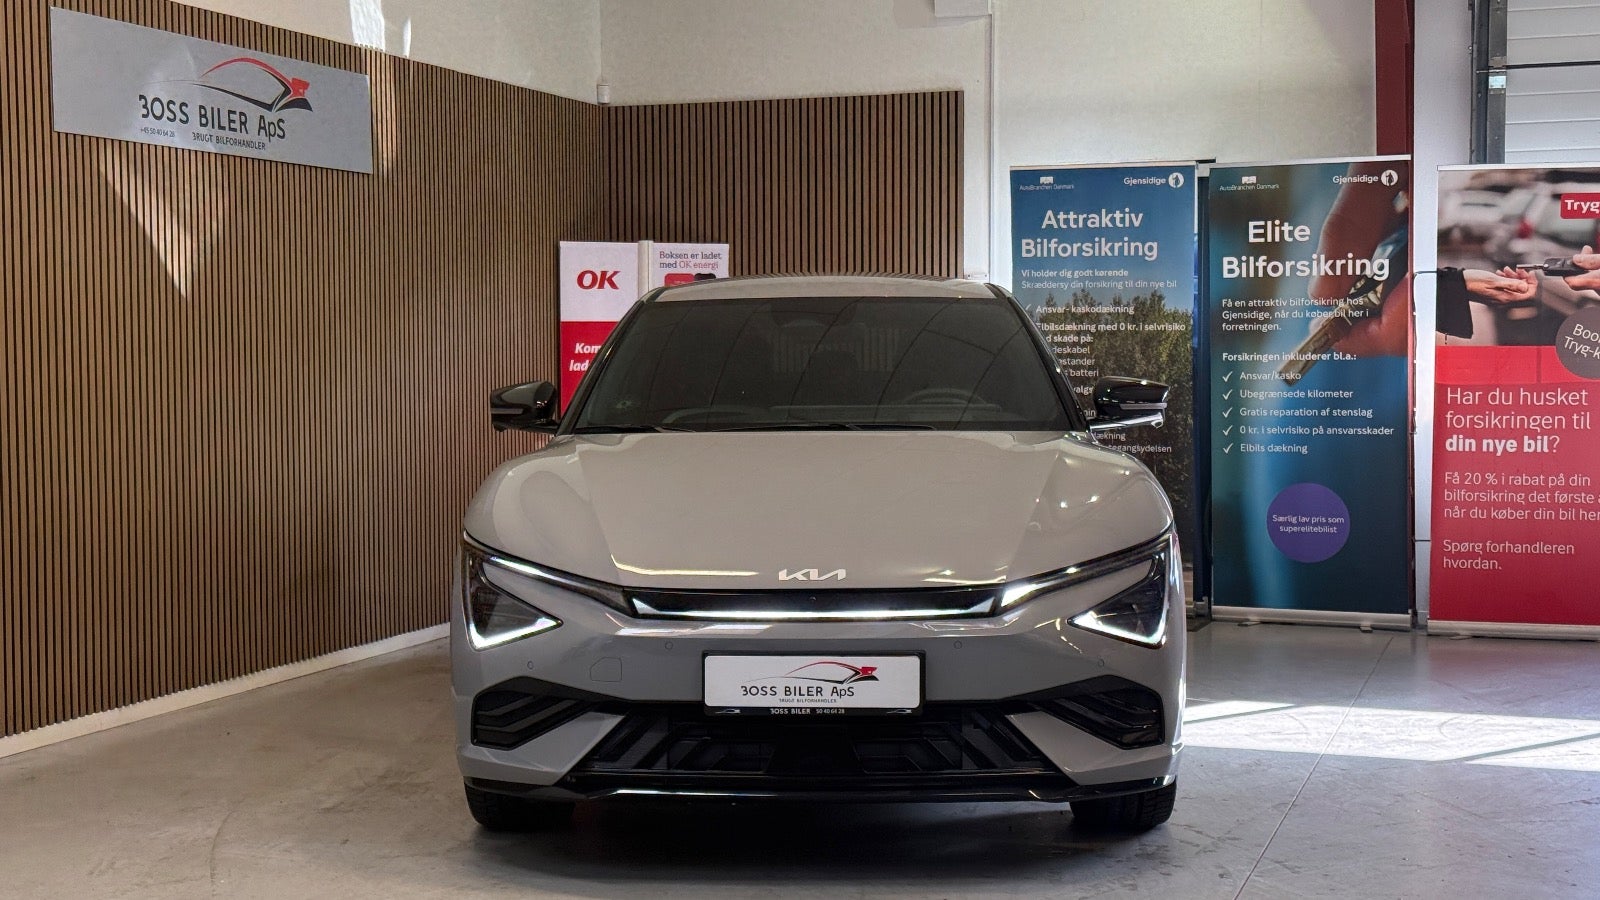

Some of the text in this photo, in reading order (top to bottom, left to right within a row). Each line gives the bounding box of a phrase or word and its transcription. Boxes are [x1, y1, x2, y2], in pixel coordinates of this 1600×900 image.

[198, 104, 249, 134] BILER
[257, 114, 286, 142] ApS
[215, 135, 266, 150] BILFORHANDLER
[1123, 176, 1167, 186] Gjensidige
[1332, 174, 1379, 186] Gjensidige
[1564, 199, 1600, 214] Tryg
[1041, 207, 1143, 229] Attraktiv
[1248, 219, 1311, 243] Elite
[1021, 236, 1158, 261] Bilforsikring
[659, 251, 722, 260] Boksen er ladet
[659, 260, 719, 271] med OK energi
[1222, 252, 1390, 281] Bilforsikring
[576, 269, 621, 290] OK
[1021, 268, 1129, 279] Vi holder dig godt kørende
[1021, 279, 1177, 290] Skræddersy din forsikring til din nye bil
[1222, 298, 1233, 308] Få
[1248, 298, 1287, 307] attraktiv
[1289, 297, 1345, 309] bilforsikring
[1346, 297, 1364, 306] hos
[1071, 304, 1135, 315] kaskodækning
[1222, 309, 1272, 321] Gjensidige,
[1274, 309, 1290, 319] når
[1291, 309, 1304, 318] du
[1305, 309, 1334, 318] køber
[1334, 309, 1346, 318] bil
[1347, 308, 1363, 317] her
[1097, 322, 1118, 331] med
[1119, 322, 1126, 331] 0
[1127, 322, 1139, 331] kr.
[1144, 322, 1186, 331] selvrisiko
[1222, 322, 1282, 332] forretningen.
[1053, 334, 1079, 343] skade
[1080, 333, 1094, 345] på:
[1572, 323, 1600, 343] Boo
[1222, 352, 1357, 362] Forsikringen inkluderer bl.a.:
[1069, 368, 1099, 377] batteri
[1239, 371, 1302, 381] Ansvar/kasko
[1239, 389, 1354, 400] Ubegrænsede kilometer
[1447, 387, 1589, 406] Har du husket
[1239, 407, 1373, 419] Gratis reparation af stenslag
[1445, 411, 1591, 433] forsikringen til
[1239, 425, 1246, 434] 0
[1248, 425, 1260, 435] kr.
[1266, 425, 1310, 435] selvrisiko
[1312, 425, 1324, 437] på
[1326, 426, 1395, 436] ansvarsskader
[1240, 443, 1309, 455] Elbils dækning
[1445, 434, 1560, 456] din nye bil?
[1444, 471, 1460, 485] Få
[1464, 472, 1482, 485] 20
[1485, 473, 1498, 485] %
[1508, 473, 1545, 486] rabat
[1548, 473, 1565, 489] på
[1569, 473, 1591, 487] din
[1444, 489, 1525, 505] bilforsikring
[1528, 491, 1550, 503] det
[1554, 490, 1595, 504] første
[1272, 514, 1297, 524] Særlig
[1298, 515, 1310, 523] lav
[1311, 515, 1327, 525] pris
[1444, 506, 1467, 519] når
[1469, 506, 1487, 519] du
[1491, 506, 1531, 520] køber
[1533, 507, 1555, 520] din
[1559, 508, 1576, 521] bil
[1279, 524, 1337, 534] superelitebilist
[1443, 540, 1575, 555] Spørg forhandleren
[1443, 556, 1502, 570] hvordan.
[784, 685, 824, 697] BILER
[830, 686, 855, 699] ApS
